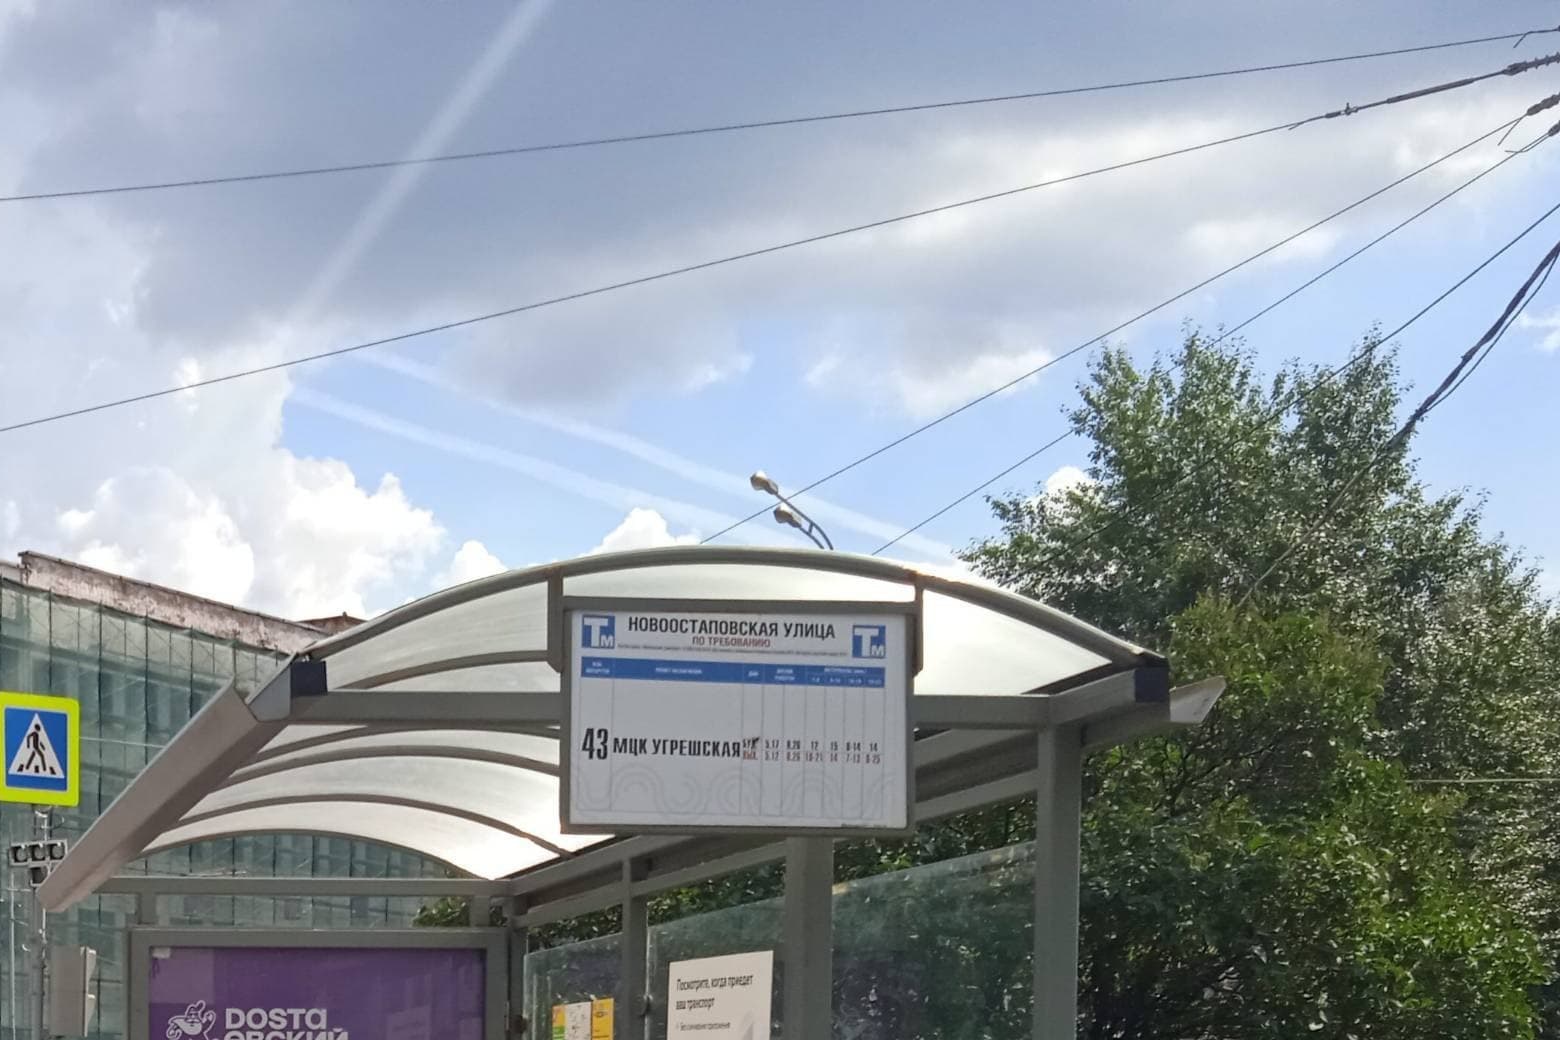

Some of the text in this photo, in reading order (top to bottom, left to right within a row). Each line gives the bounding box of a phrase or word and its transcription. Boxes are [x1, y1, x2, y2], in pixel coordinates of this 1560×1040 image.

[628, 616, 836, 641] НОВООСТАПОВСКАЯ УЛИЦА
[692, 635, 771, 648] ПО ТРЕБОВАНИЮ
[581, 727, 609, 760] 43
[612, 737, 740, 757] МЦК УГРЕШСКАЯ
